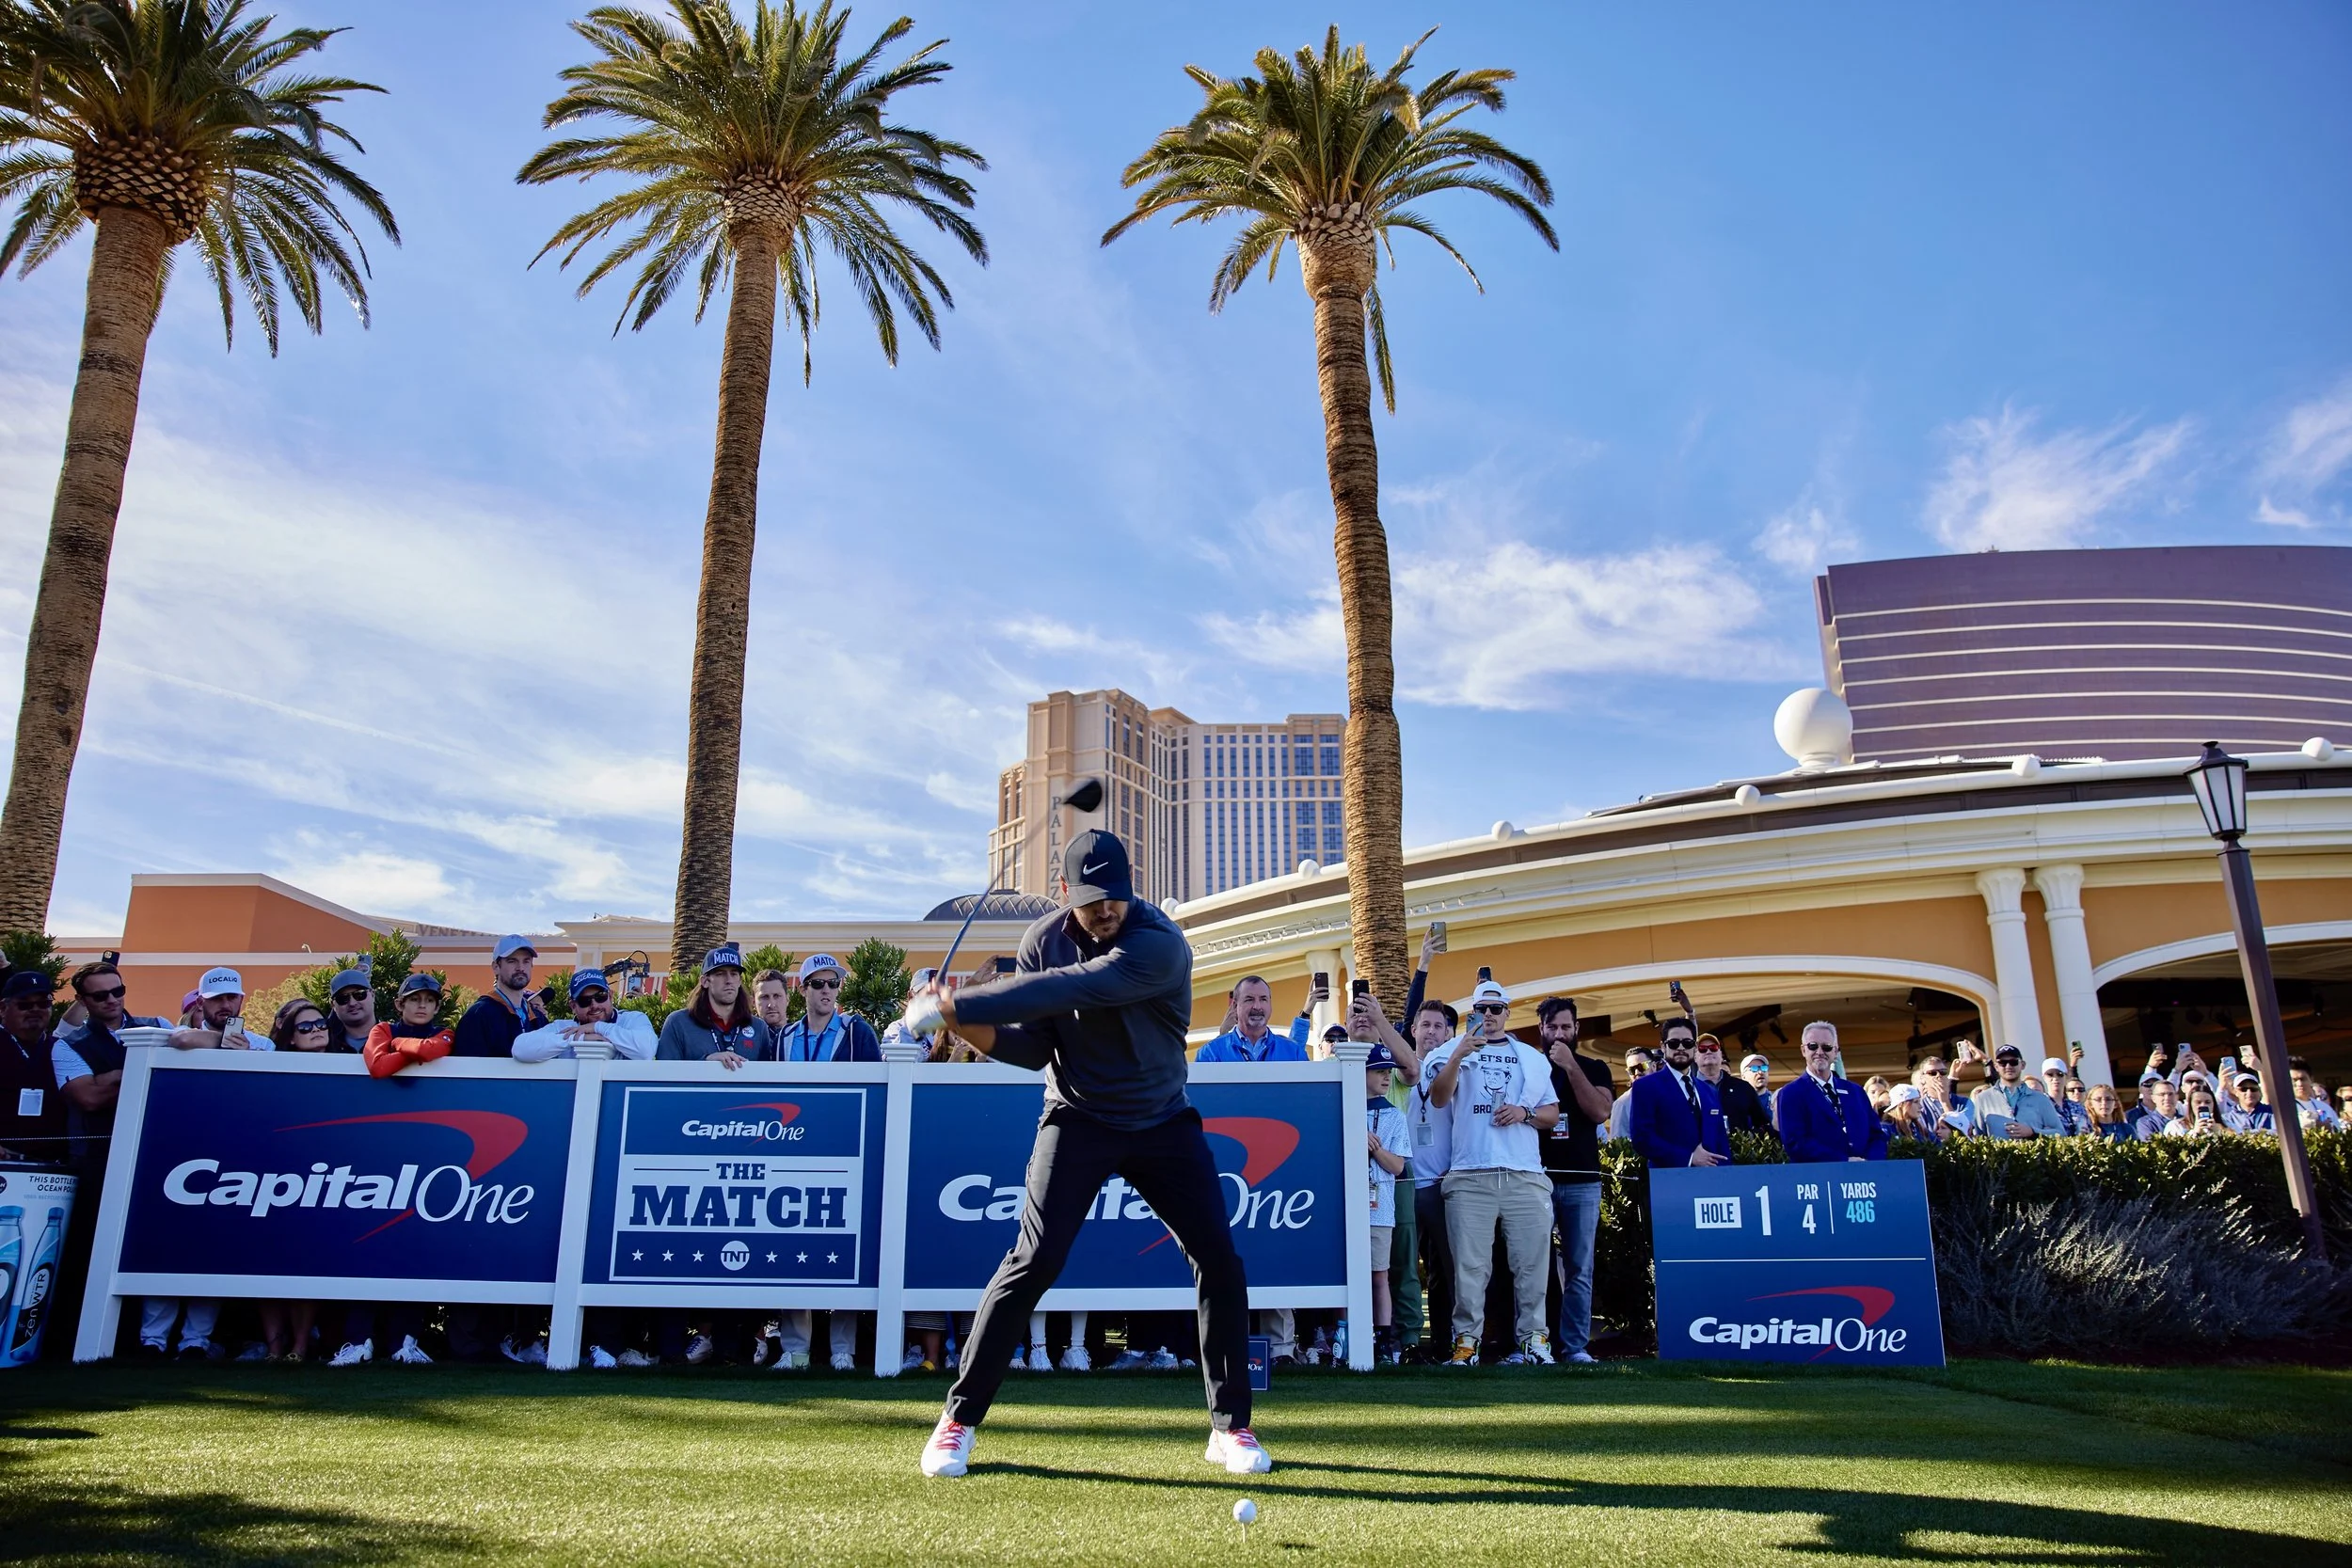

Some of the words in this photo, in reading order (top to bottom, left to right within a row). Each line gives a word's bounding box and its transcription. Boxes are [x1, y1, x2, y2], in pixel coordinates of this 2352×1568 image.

[1049, 796, 1062, 900] PALAZZ
[713, 952, 739, 965] MATCH
[813, 956, 836, 968] MATCH
[1478, 1053, 1502, 1063] ET'S
[1504, 1055, 1518, 1064] GO
[29, 1175, 48, 1183] THIS
[716, 1163, 766, 1180] THE
[1796, 1183, 1820, 1200] PAR
[1840, 1181, 1877, 1199] YARDS
[628, 1184, 848, 1228] MATCH
[1700, 1202, 1735, 1224] HOLE
[1755, 1185, 1772, 1236] 1
[1846, 1200, 1876, 1223] 486
[1802, 1203, 1817, 1234] 4
[721, 1250, 750, 1263] TNT
